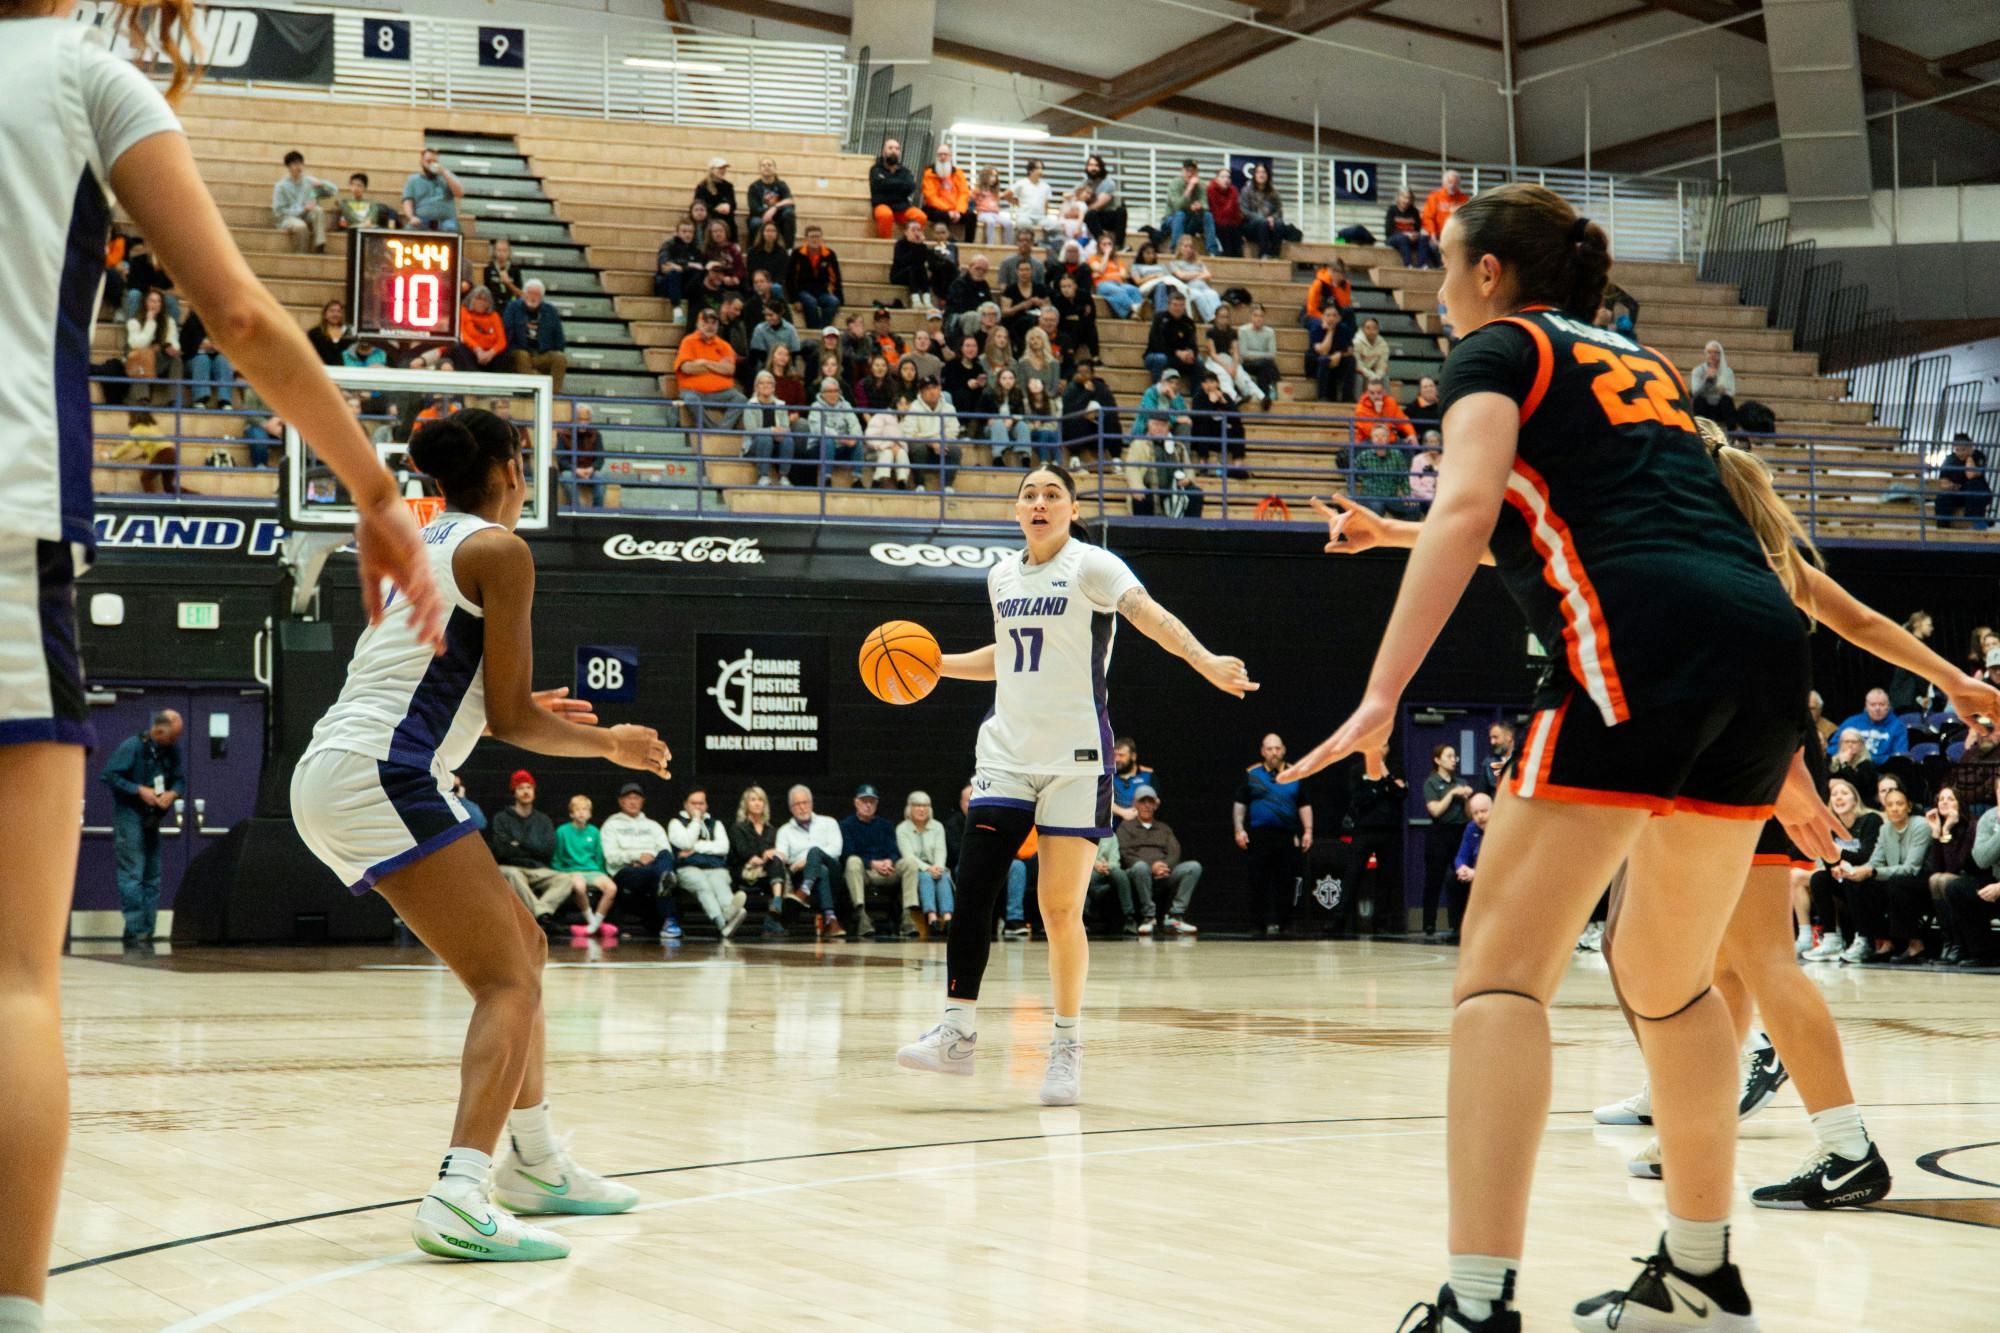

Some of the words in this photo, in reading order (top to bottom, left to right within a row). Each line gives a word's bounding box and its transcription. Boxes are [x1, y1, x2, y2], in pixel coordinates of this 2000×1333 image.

[378, 25, 395, 52] 8
[491, 34, 510, 60] 9
[1342, 168, 1370, 195] 10
[386, 239, 450, 272] 7:44
[393, 273, 439, 327] 10
[1572, 341, 1697, 433] 22
[602, 533, 766, 564] Coca-Cola
[185, 606, 213, 625] EXIT
[1008, 627, 1044, 673] 17
[587, 656, 624, 690] 8B
[752, 659, 801, 675] CHANGE
[752, 678, 801, 693] JUSTICE
[752, 696, 808, 712] EQUALITY
[752, 715, 818, 731] EDUCATION
[705, 735, 743, 750] BLACK
[743, 736, 774, 751] LIVES
[775, 736, 818, 751] MATTER
